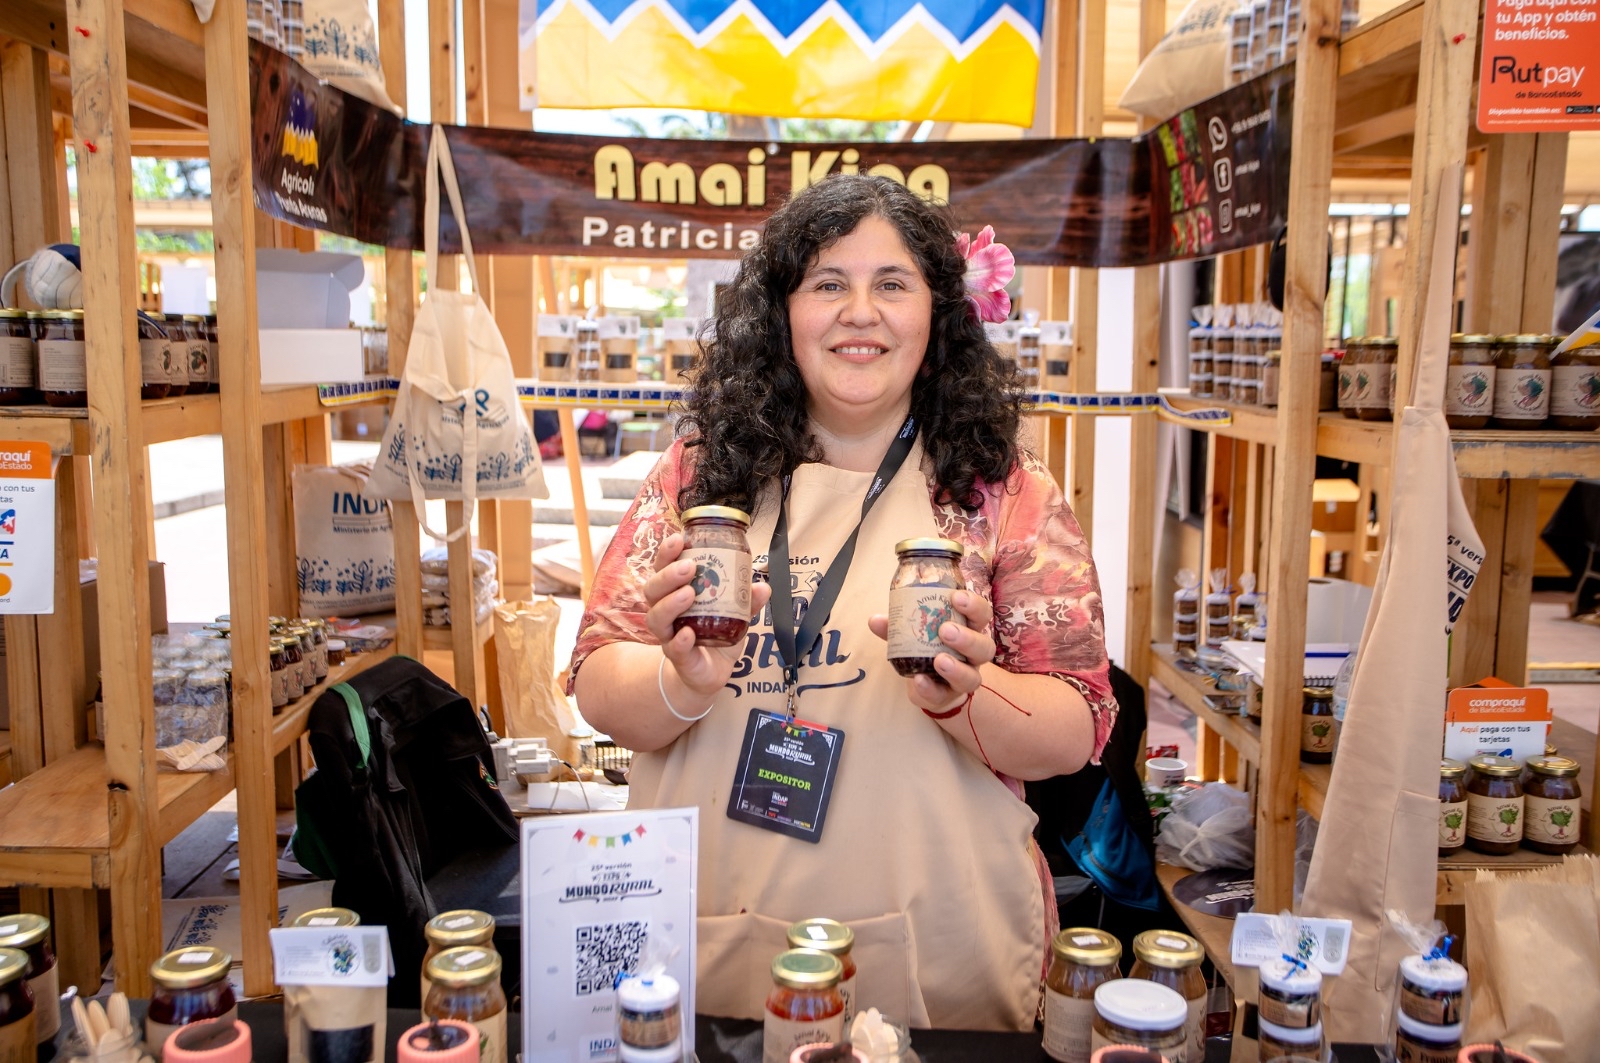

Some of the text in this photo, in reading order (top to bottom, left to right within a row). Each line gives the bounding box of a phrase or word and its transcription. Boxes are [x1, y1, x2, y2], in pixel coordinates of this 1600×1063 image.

[1496, 9, 1597, 27] tu App y obtén
[1494, 26, 1569, 41] beneficios.
[1491, 56, 1585, 88] Rutpay
[593, 144, 767, 207] Amai
[582, 216, 762, 251] Patricia
[1447, 560, 1475, 590] XPO
[1469, 697, 1526, 708] compraquí
[1460, 726, 1478, 734] Aquí
[1480, 727, 1500, 736] paga
[1479, 736, 1511, 744] tarjetas
[758, 768, 811, 791] EXPOSITOR
